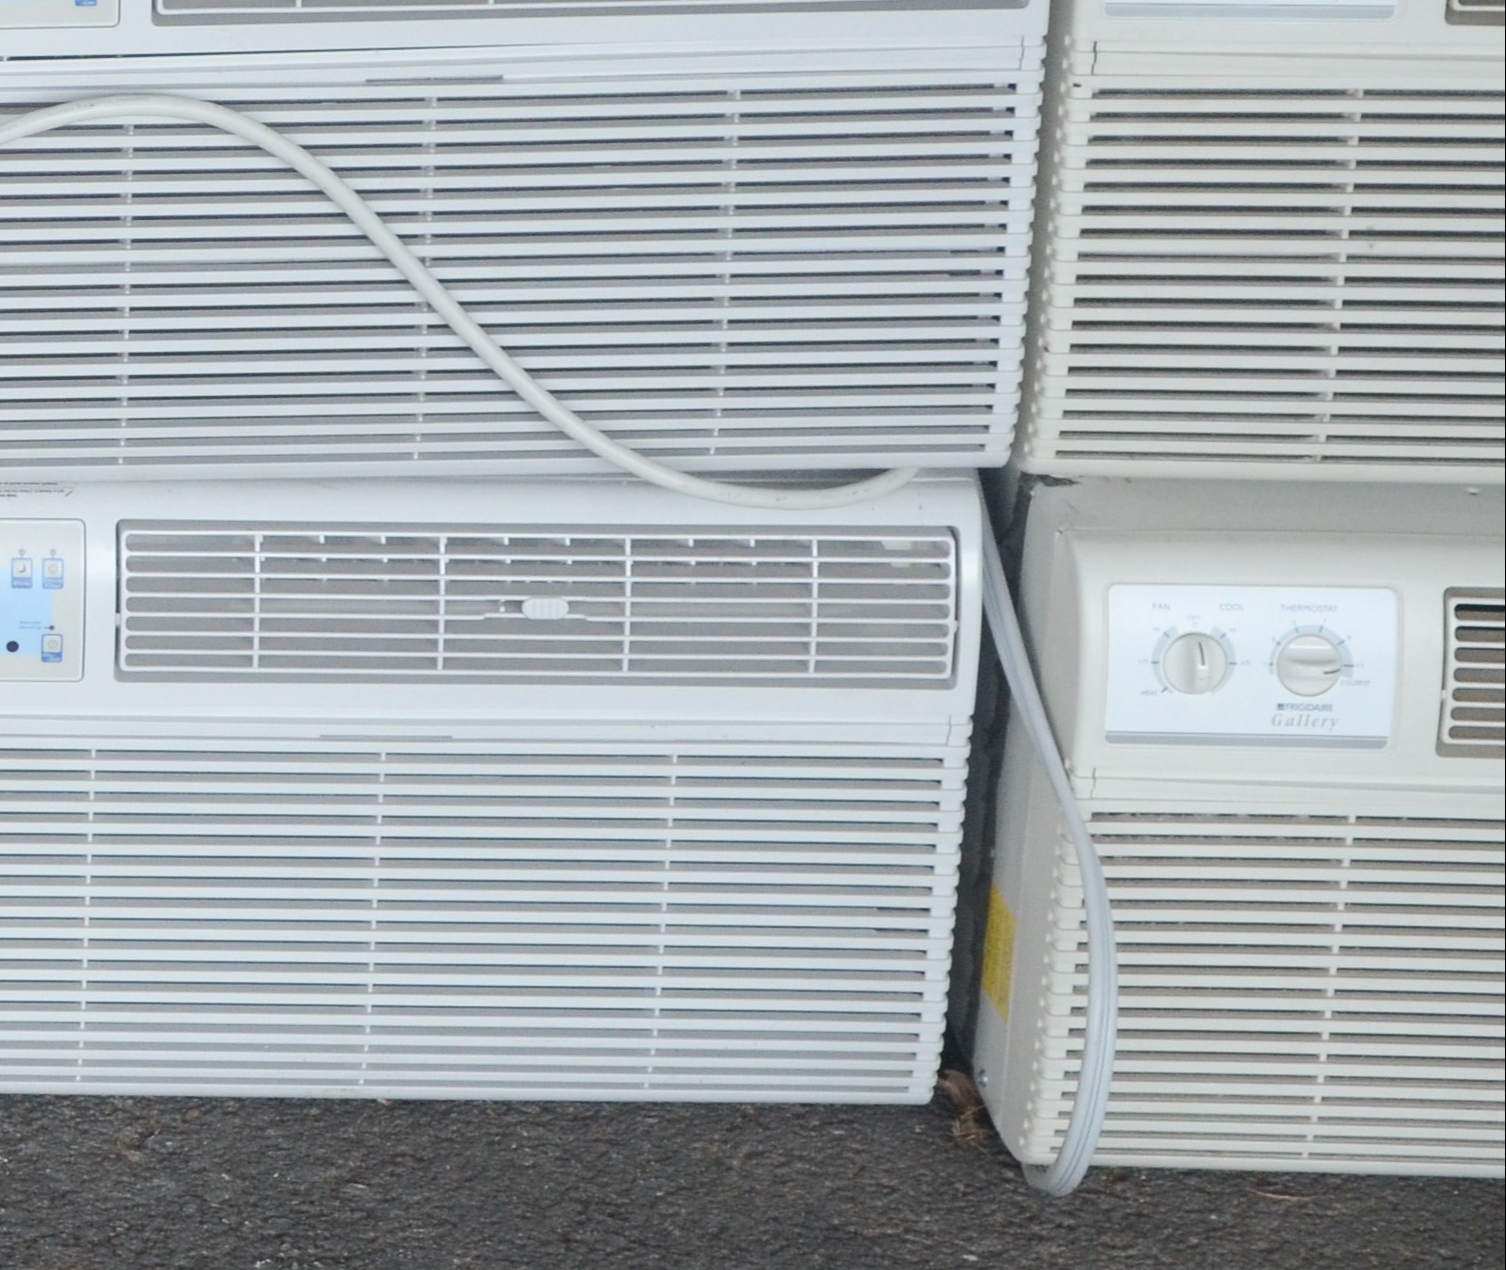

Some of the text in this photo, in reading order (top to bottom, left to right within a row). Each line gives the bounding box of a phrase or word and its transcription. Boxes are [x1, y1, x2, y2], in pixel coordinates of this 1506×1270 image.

[1151, 602, 1171, 610] FAN
[1218, 603, 1244, 611] COOL
[1280, 603, 1338, 612] THERMOSTAT
[1284, 703, 1333, 712] FRIGIDAIRE
[1271, 713, 1339, 731] Gallery
